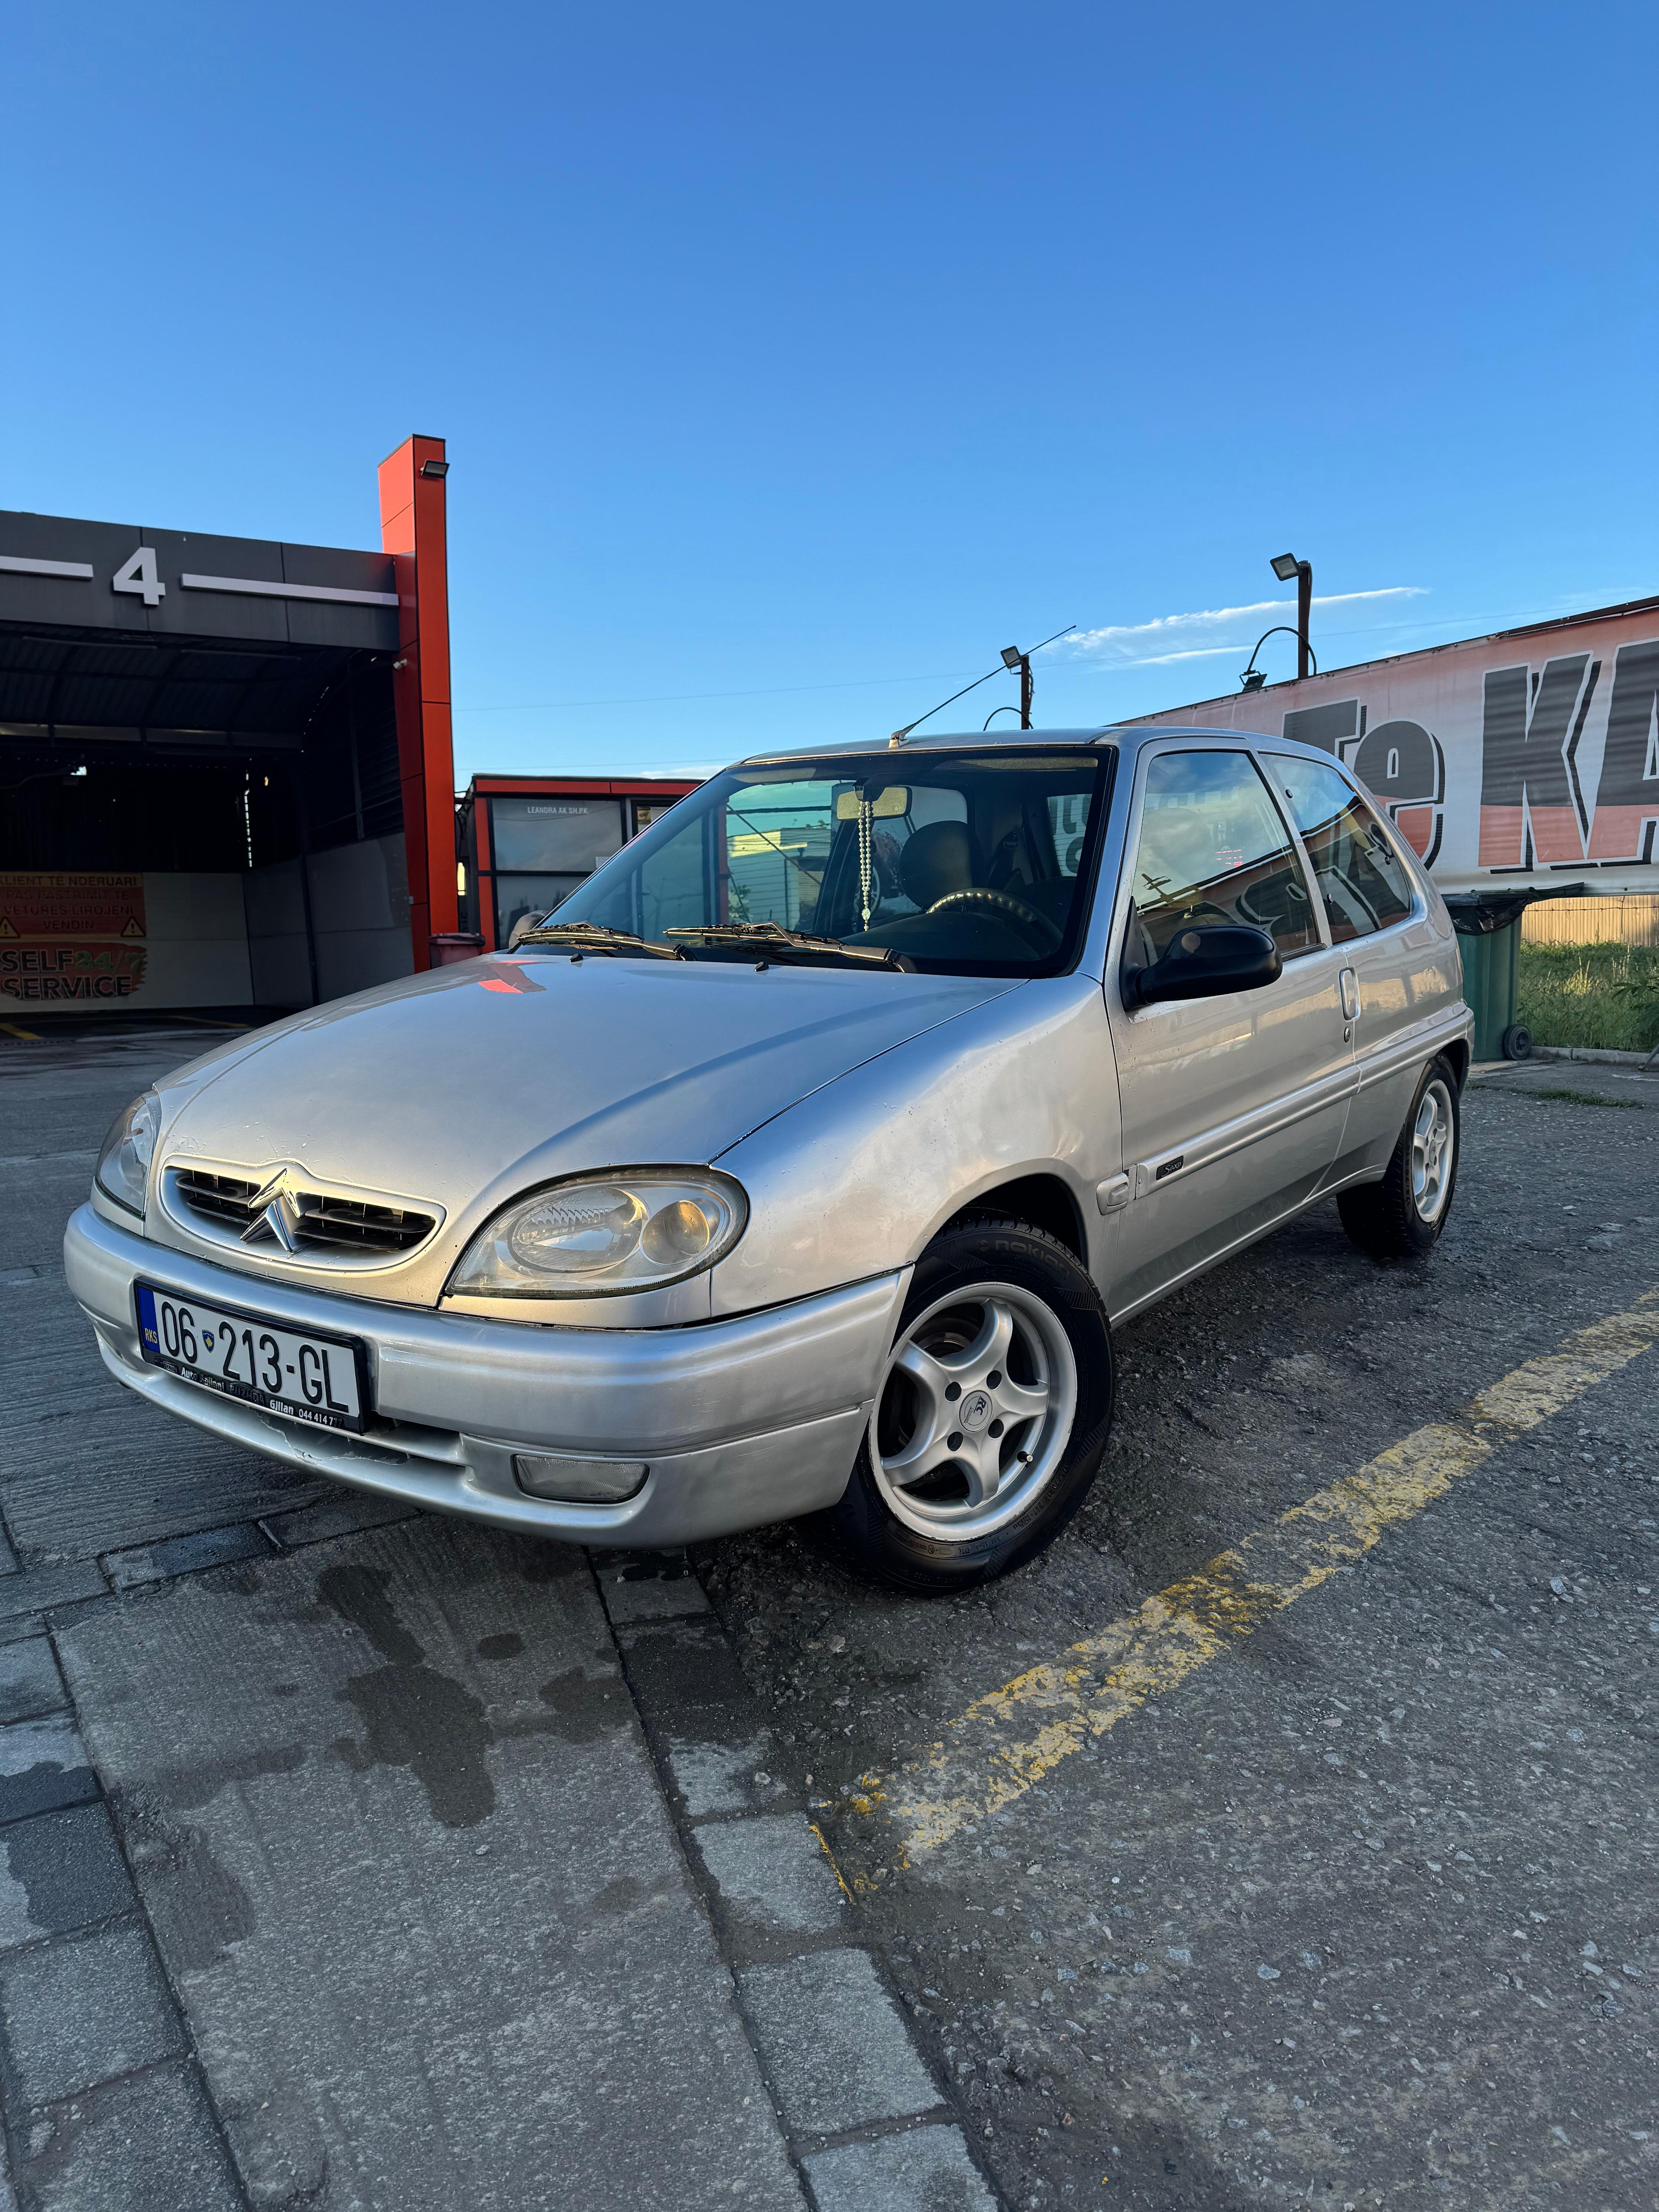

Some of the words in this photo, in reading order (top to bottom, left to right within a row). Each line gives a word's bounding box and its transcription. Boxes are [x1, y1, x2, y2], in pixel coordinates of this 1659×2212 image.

[113, 547, 166, 605] 4
[0, 949, 74, 974] SELF
[74, 950, 146, 974] 24/7
[2, 975, 132, 1001] SERVICE
[1161, 1162, 1181, 1177] Saxo
[144, 1328, 158, 1344] RKS
[161, 1301, 198, 1364] 06
[219, 1321, 349, 1413] 213-GL
[181, 1367, 197, 1381] Auto
[299, 1408, 312, 1420] 044
[314, 1413, 328, 1424] 414
